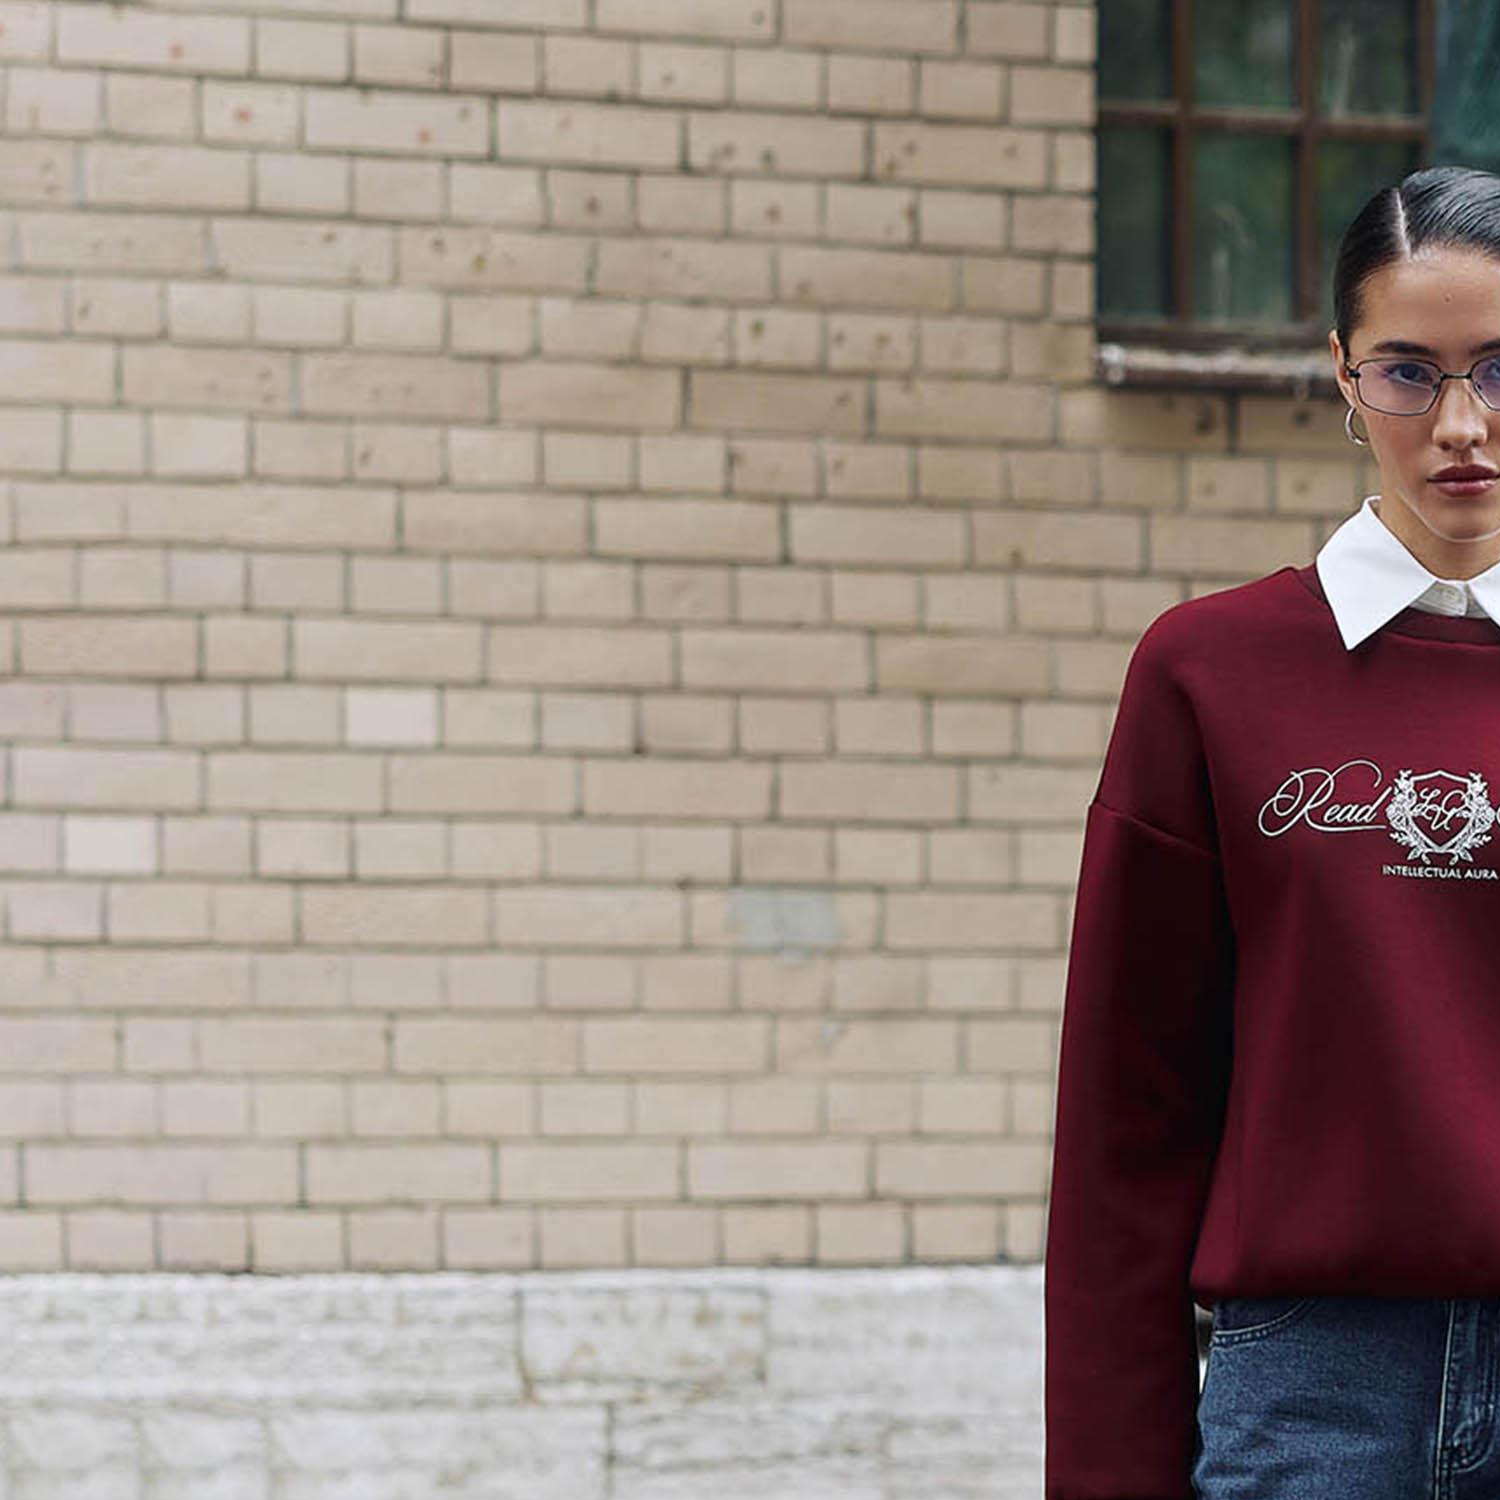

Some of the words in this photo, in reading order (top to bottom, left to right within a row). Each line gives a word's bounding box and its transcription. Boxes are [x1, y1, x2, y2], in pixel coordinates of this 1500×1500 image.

[1258, 760, 1392, 836] Read
[1382, 865, 1461, 879] INTELLECTUAL
[1464, 869, 1498, 880] AURA
